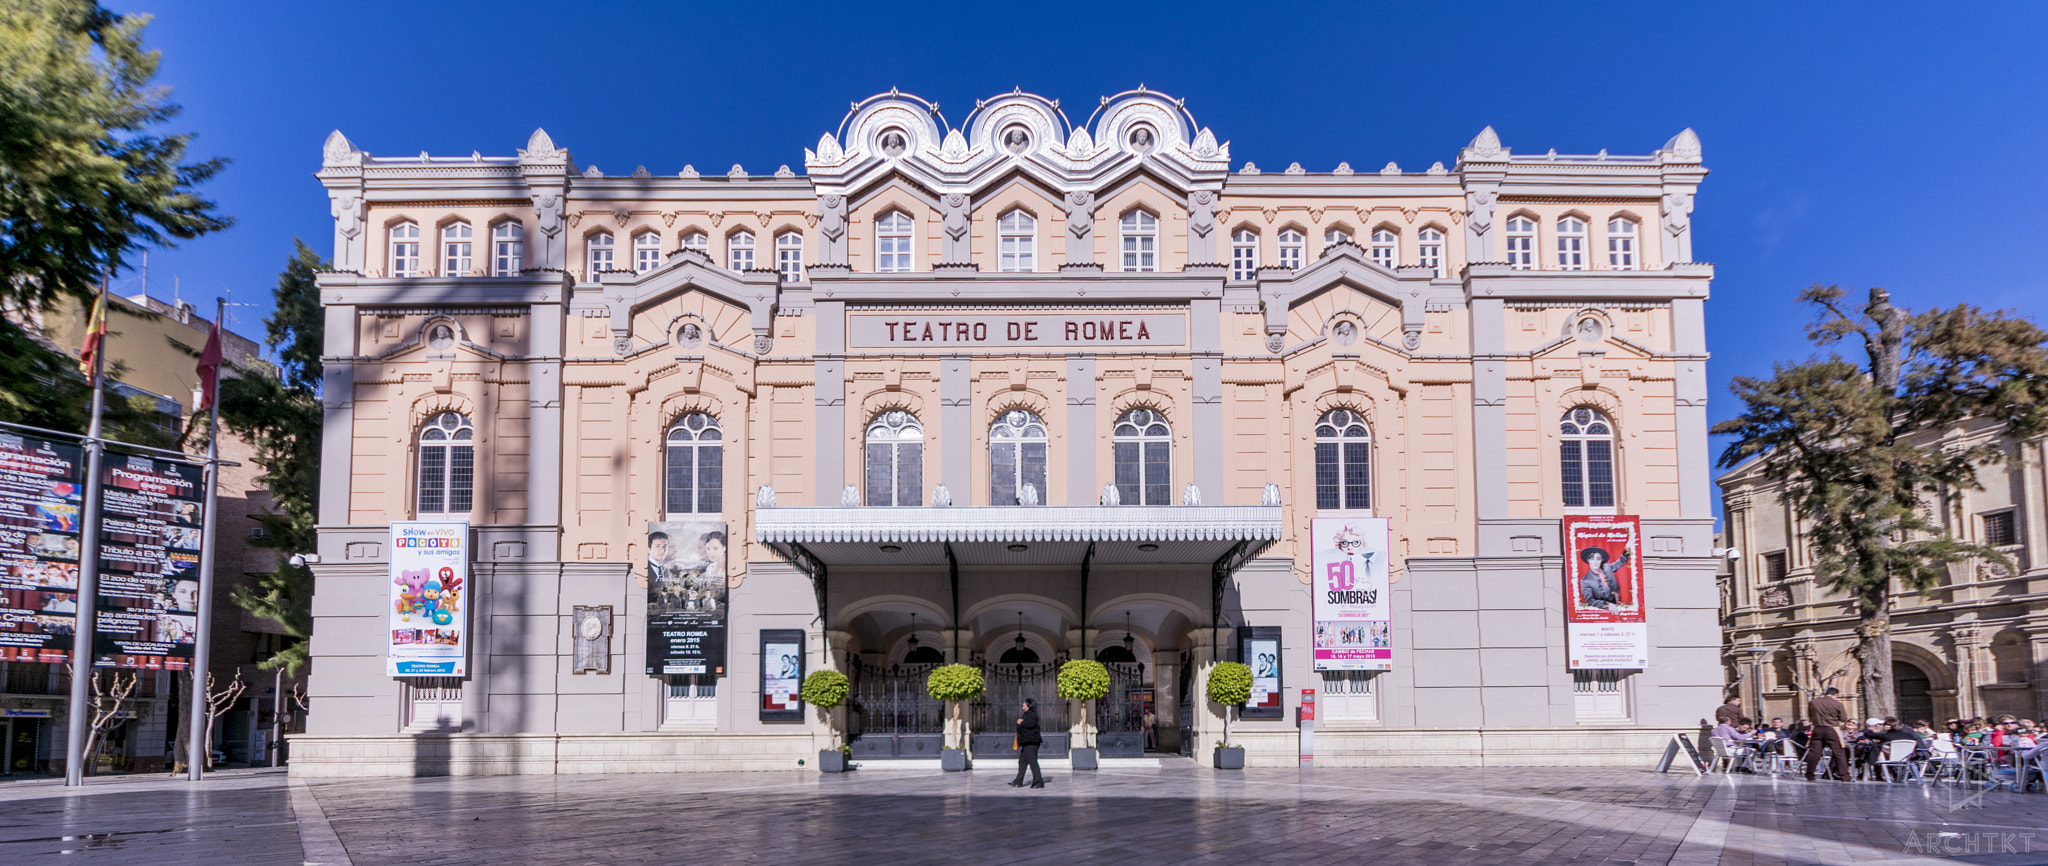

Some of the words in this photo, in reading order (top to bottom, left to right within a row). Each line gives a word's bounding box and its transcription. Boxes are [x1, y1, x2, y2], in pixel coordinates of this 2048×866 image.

[885, 321, 987, 342] TEATRO
[1006, 321, 1038, 342] DE
[1065, 319, 1150, 341] ROMEA
[112, 468, 193, 488] Programación
[140, 482, 167, 491] ENERO
[103, 489, 128, 498] María
[102, 517, 136, 528] Patente
[397, 538, 460, 547] POCOYO
[100, 545, 135, 555] Tributo
[1327, 560, 1355, 592] 50
[1327, 588, 1377, 605] SOMBRAS!
[2, 613, 38, 623] Canto
[97, 610, 114, 618] Las
[115, 613, 157, 621] amistades
